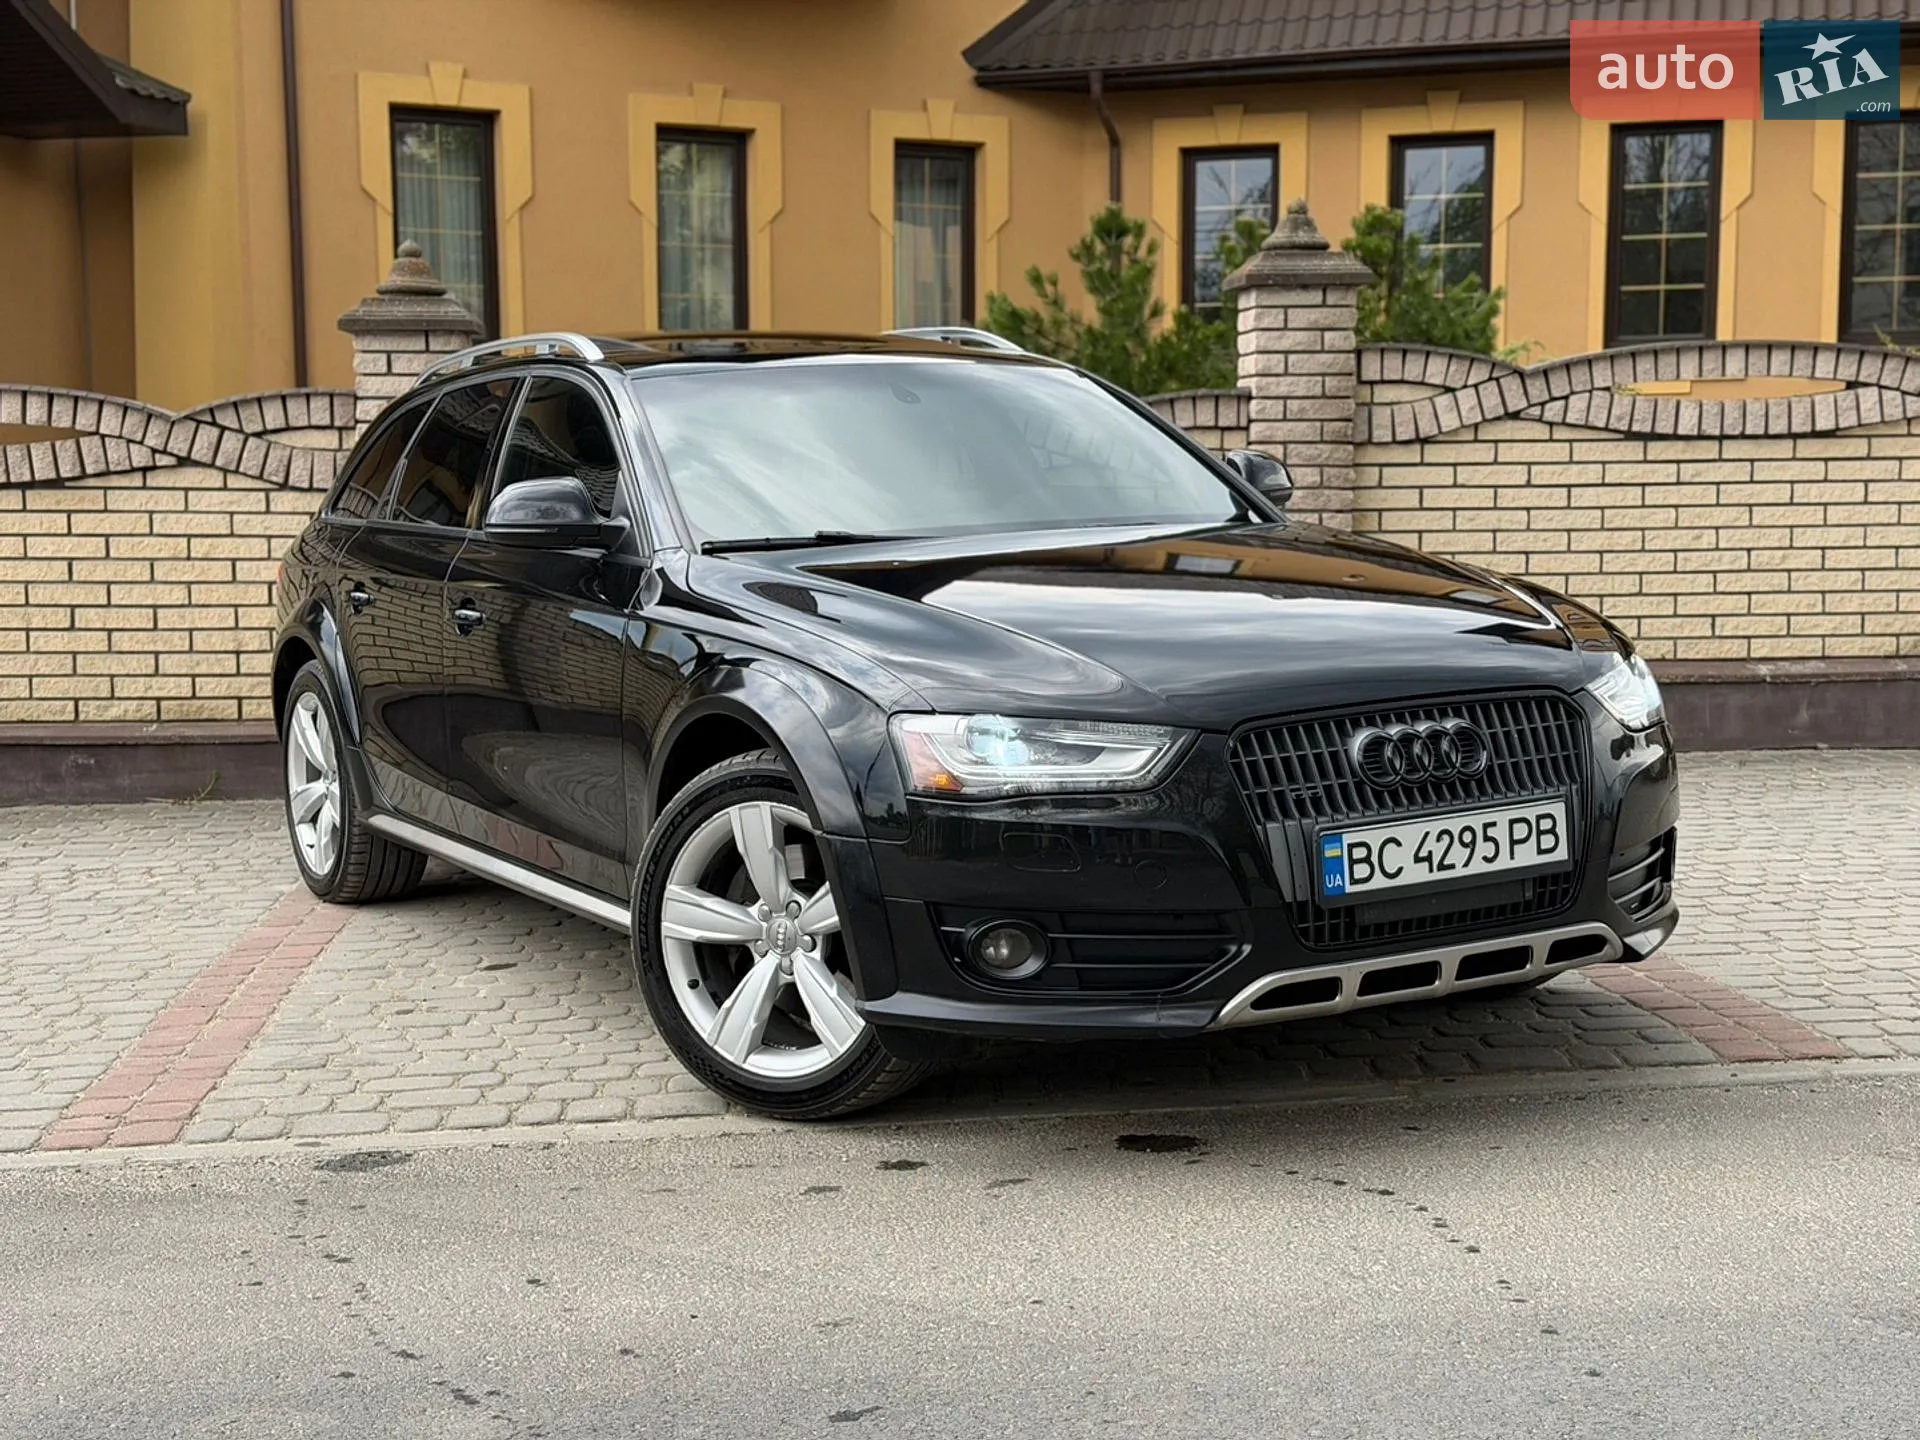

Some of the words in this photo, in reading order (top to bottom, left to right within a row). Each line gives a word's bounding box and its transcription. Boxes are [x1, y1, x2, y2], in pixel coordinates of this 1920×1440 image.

[1347, 838, 1404, 886] BC
[1413, 821, 1500, 874] 4295
[1508, 812, 1560, 861] PB
[1325, 874, 1343, 888] UA
